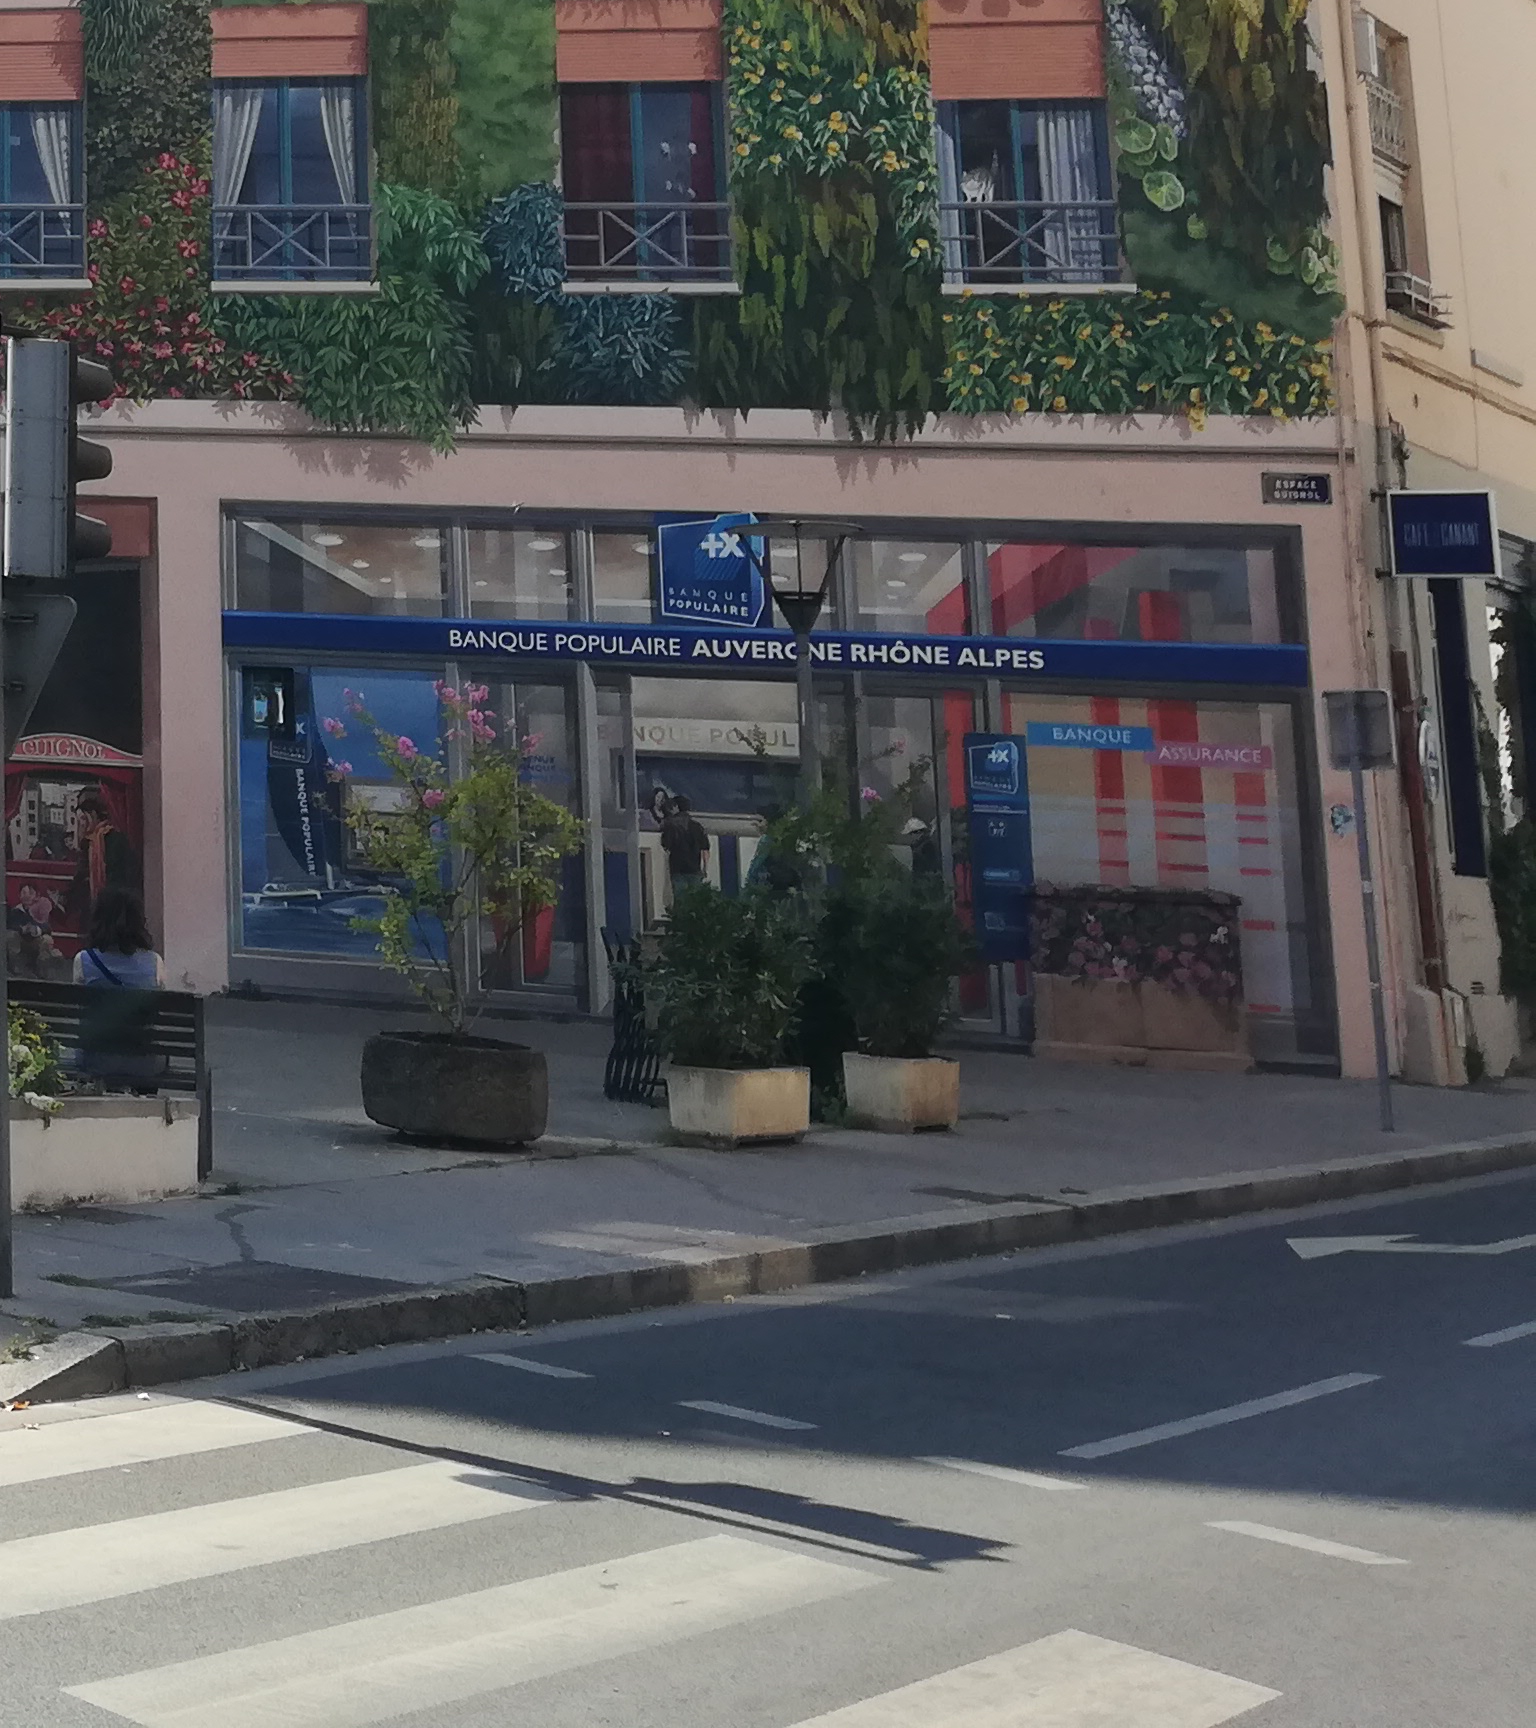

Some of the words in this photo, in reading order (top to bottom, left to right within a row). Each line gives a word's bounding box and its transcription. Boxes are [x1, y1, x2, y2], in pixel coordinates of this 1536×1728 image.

[668, 586, 749, 603] BANQUE
[668, 598, 749, 617] POPULAIRE
[448, 629, 548, 653] BANQUE
[554, 633, 682, 656] POPULAIRE
[850, 640, 950, 666] RHÔNE
[956, 646, 1045, 670] ALPES
[1052, 727, 1132, 745] BANQUE
[22, 737, 106, 759] GUIGNOL
[1158, 746, 1262, 764] ASSURANCE
